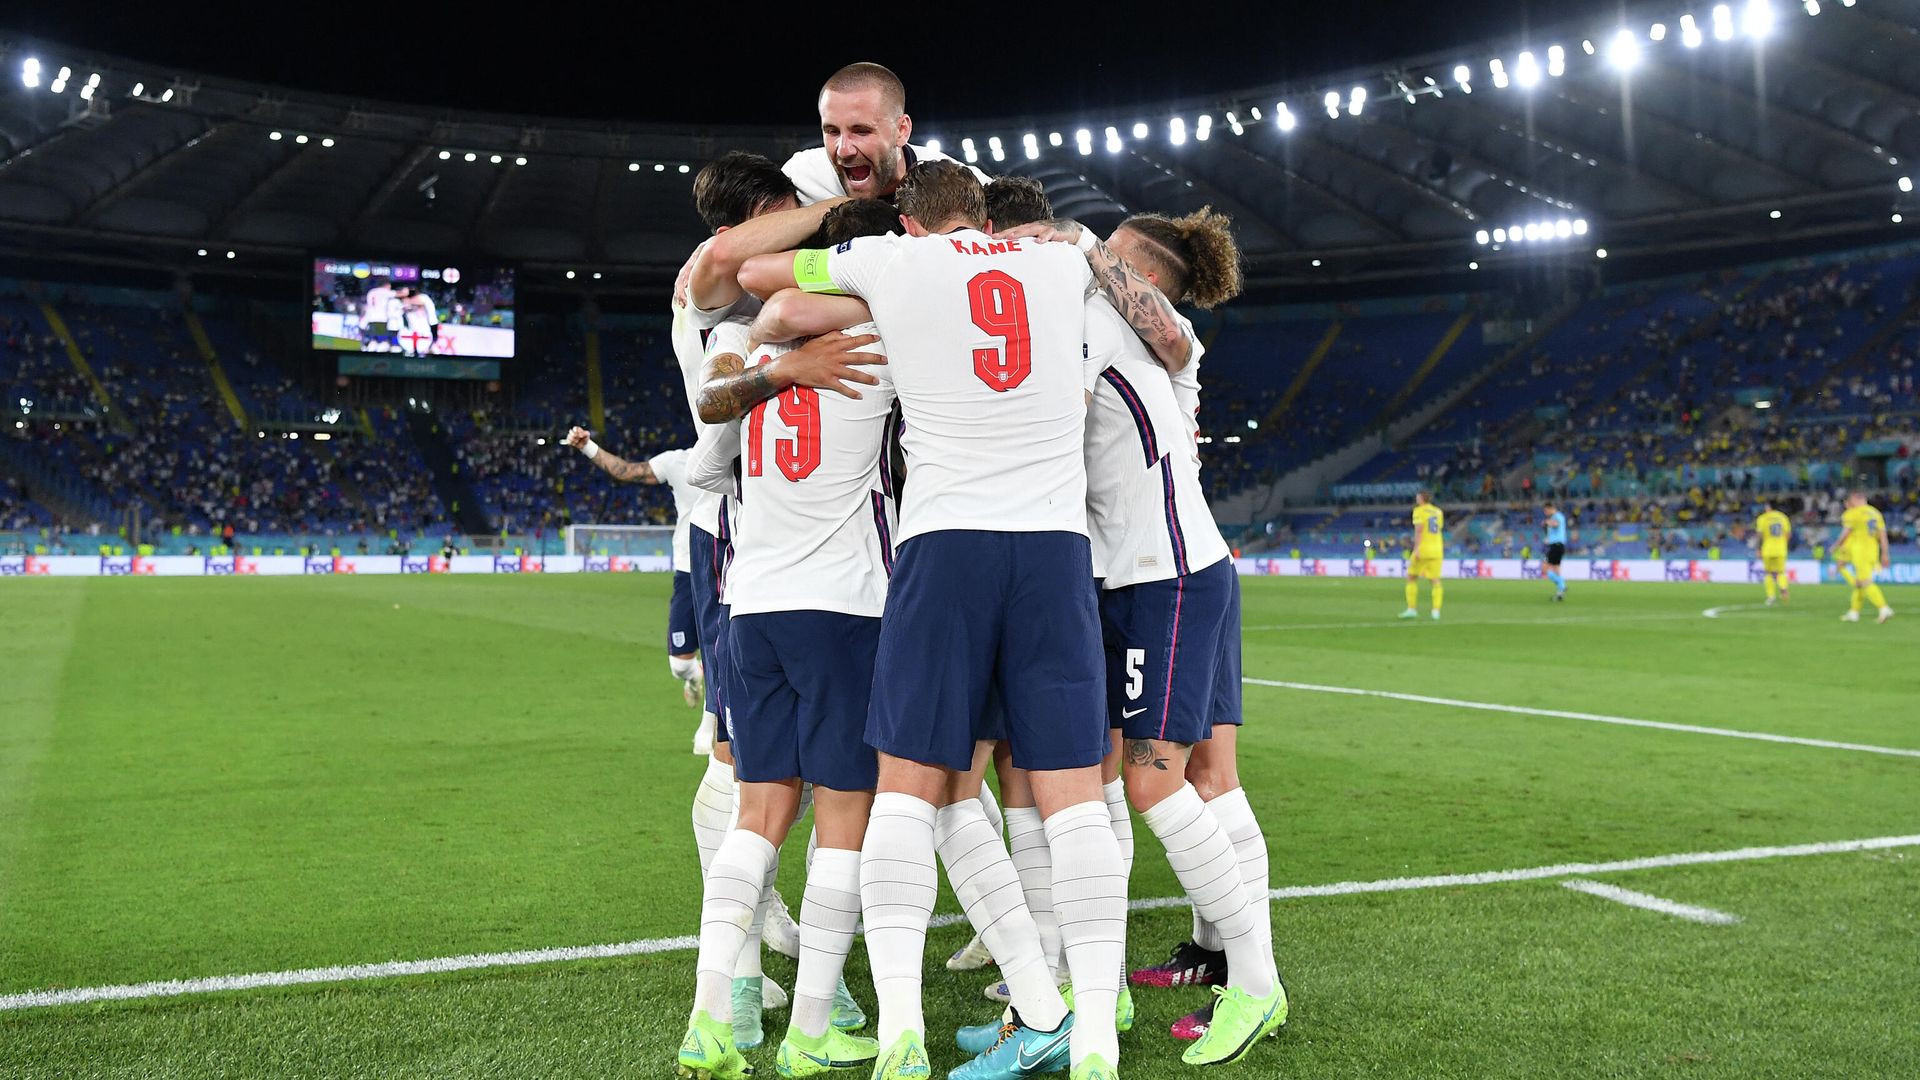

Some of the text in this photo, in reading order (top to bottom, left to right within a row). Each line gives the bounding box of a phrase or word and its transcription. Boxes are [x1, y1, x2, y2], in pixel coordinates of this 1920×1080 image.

[949, 238, 1022, 256] KANE
[967, 269, 1032, 392] 9
[748, 354, 821, 482] 19
[0, 556, 49, 575] edEx
[101, 555, 155, 575] FedEx
[205, 556, 257, 574] FedEx
[304, 556, 356, 574] FedEx
[494, 556, 541, 573] FedEx
[584, 556, 631, 573] FedEx
[1125, 648, 1145, 701] 5
